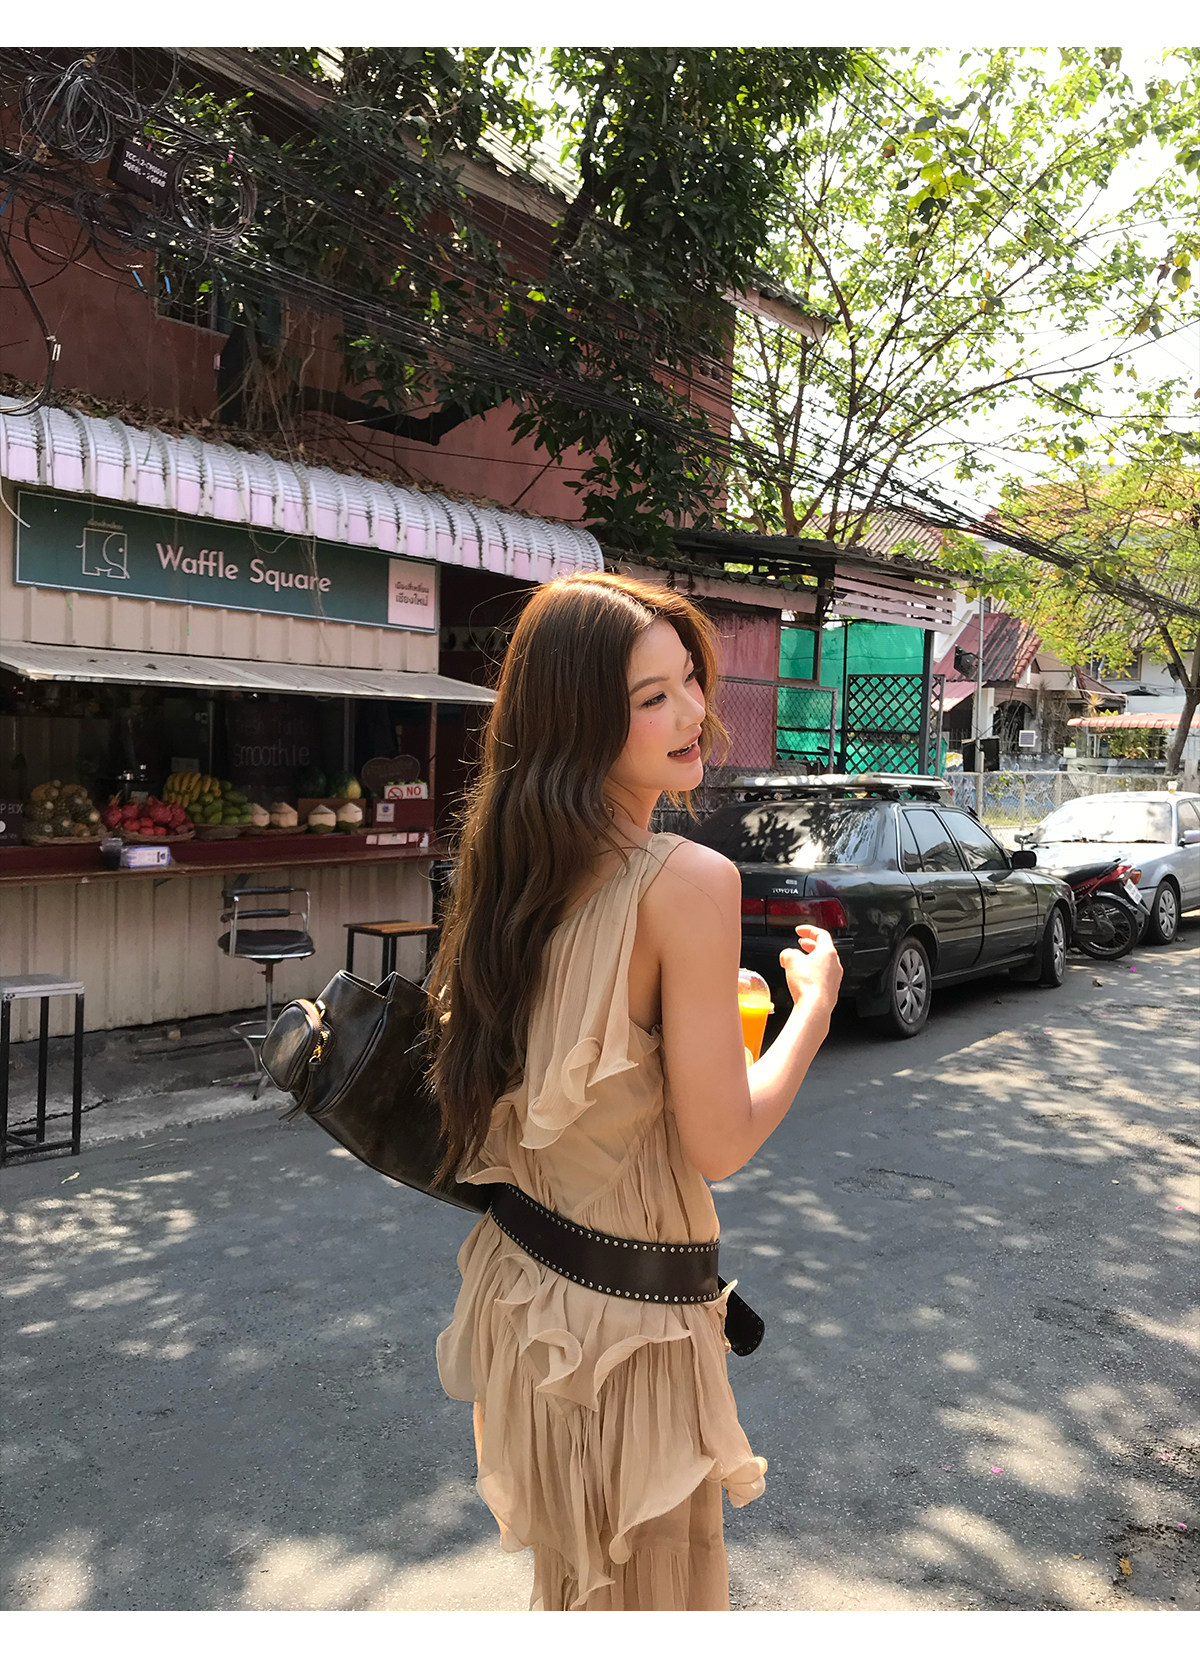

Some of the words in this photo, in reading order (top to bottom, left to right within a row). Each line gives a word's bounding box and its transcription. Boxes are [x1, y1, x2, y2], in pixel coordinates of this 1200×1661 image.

[156, 543, 239, 580] Waffle
[249, 558, 332, 592] Square
[232, 738, 311, 768] smoothie
[406, 786, 422, 796] NO
[8, 803, 24, 814] BOX
